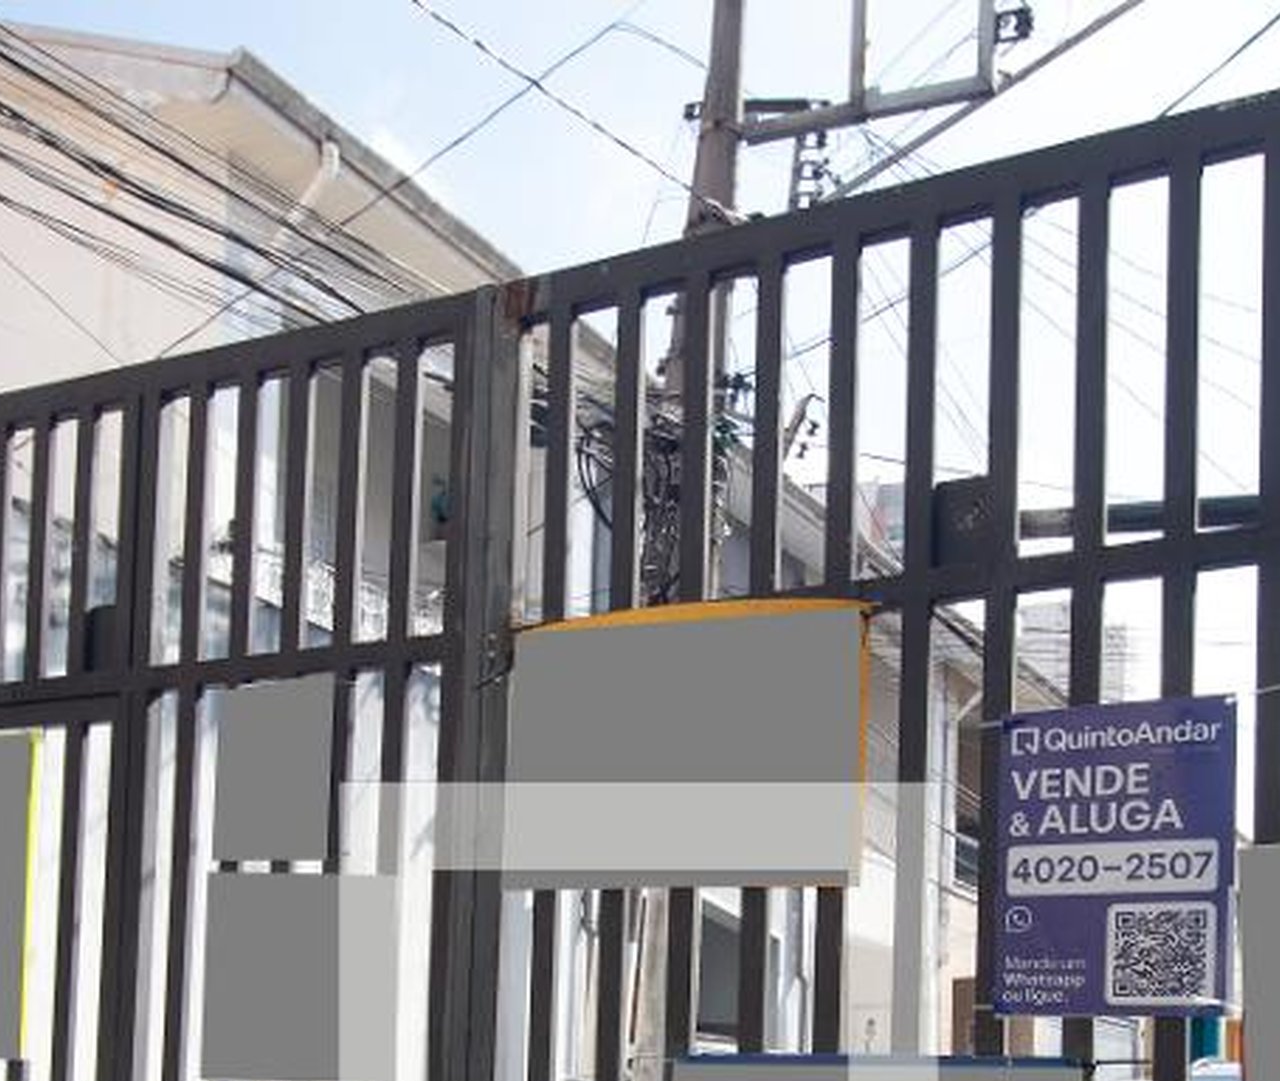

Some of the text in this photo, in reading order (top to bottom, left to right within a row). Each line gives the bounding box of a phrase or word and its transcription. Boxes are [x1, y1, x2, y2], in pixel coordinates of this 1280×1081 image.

[1044, 721, 1220, 750] QuintoAndar
[1010, 763, 1150, 800] VENDE
[1009, 799, 1184, 837] & ALUGA
[1011, 852, 1214, 884] 4020-2507
[1002, 989, 1023, 1003] ou
